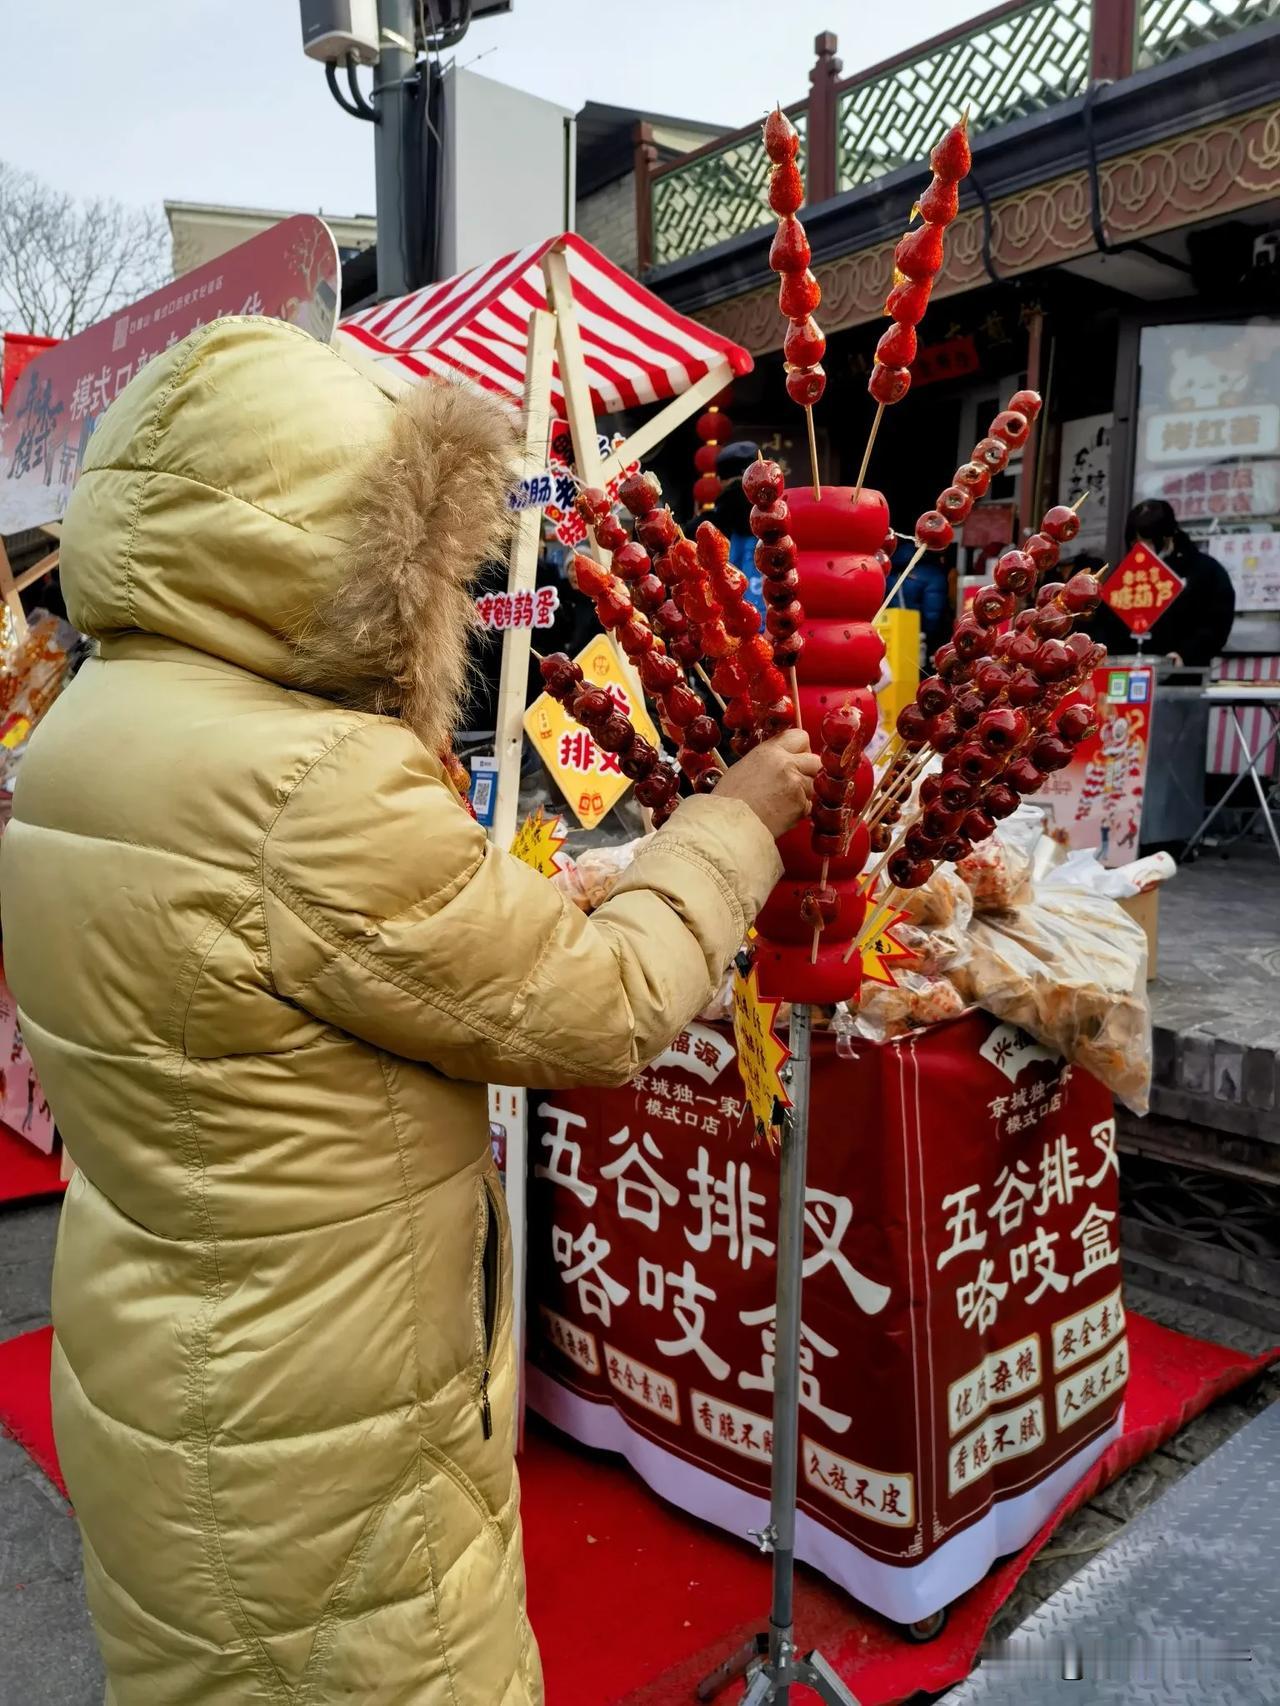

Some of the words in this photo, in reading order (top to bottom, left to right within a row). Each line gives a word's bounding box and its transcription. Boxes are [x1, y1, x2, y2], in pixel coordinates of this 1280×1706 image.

[631, 1073, 741, 1119] 京城独一家
[533, 1101, 892, 1316] 五谷排叉
[936, 1117, 1120, 1272] 五谷排叉
[551, 1223, 853, 1435] 咯吱盒
[956, 1202, 1120, 1337] 咯吱盒
[608, 1354, 673, 1412] 安全素油
[809, 1450, 907, 1518] 久放不皮
